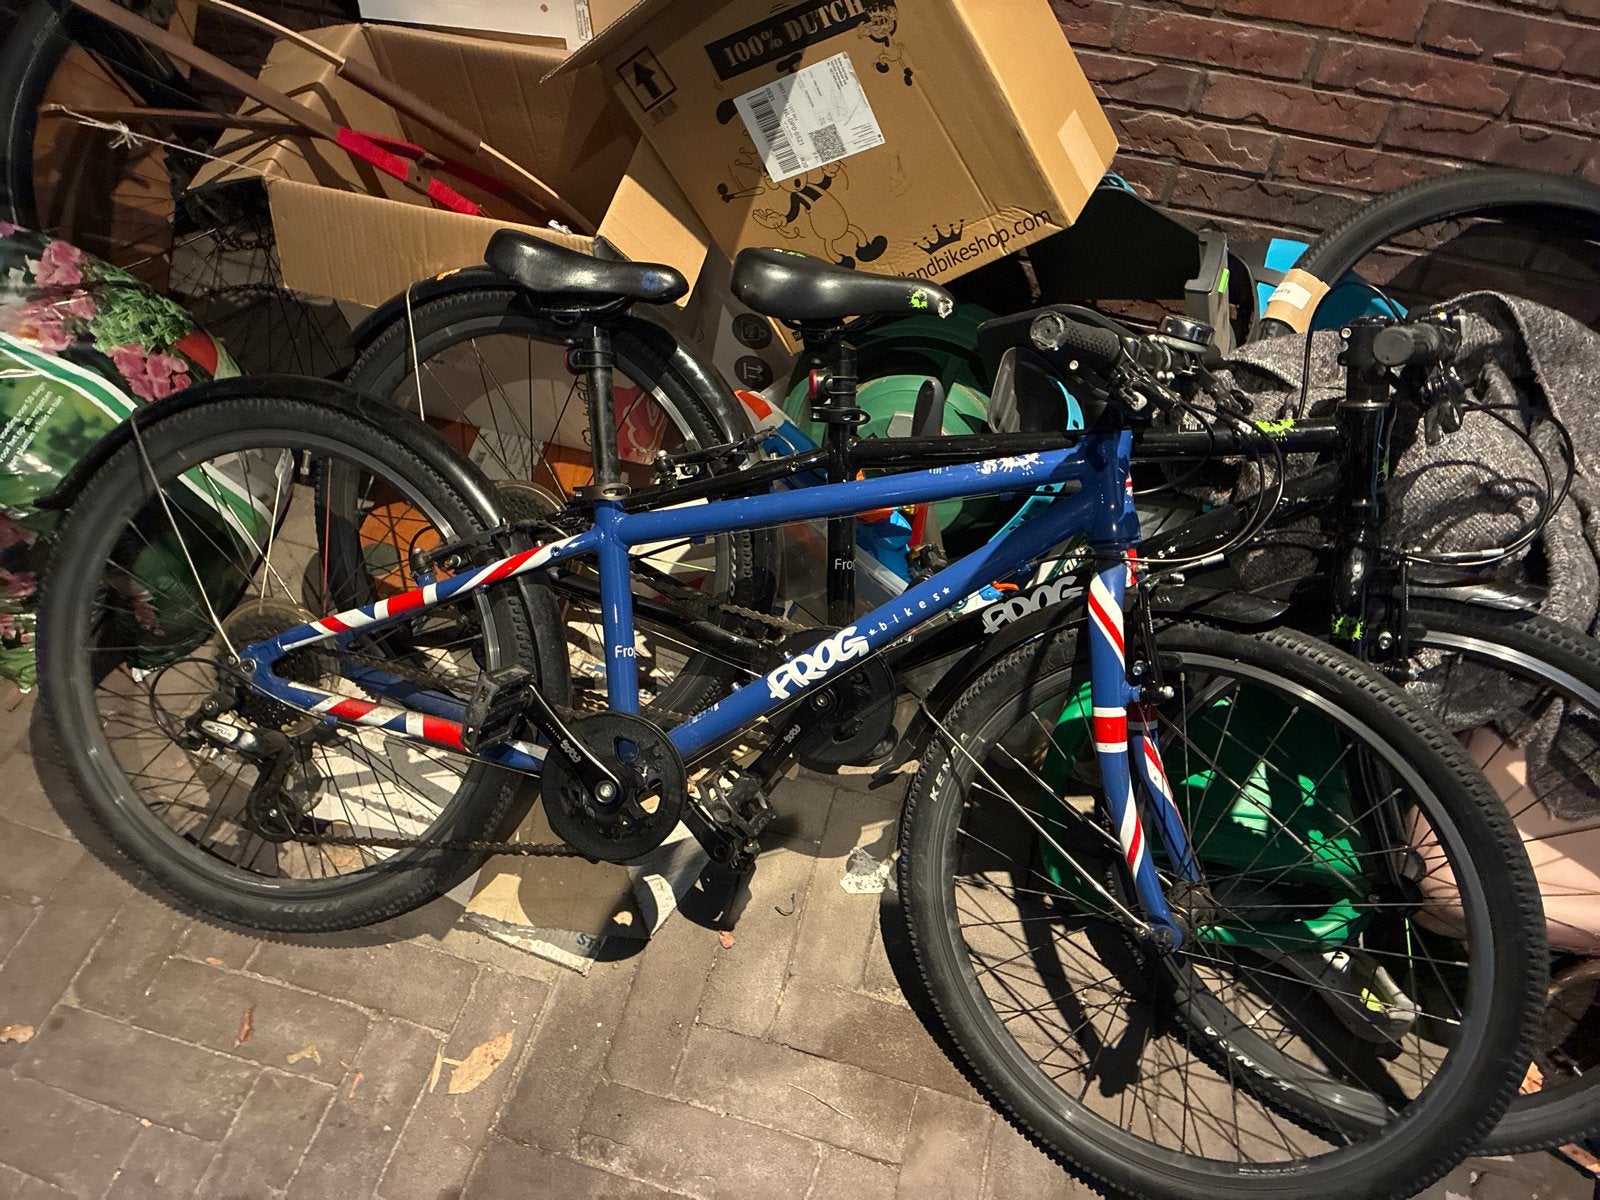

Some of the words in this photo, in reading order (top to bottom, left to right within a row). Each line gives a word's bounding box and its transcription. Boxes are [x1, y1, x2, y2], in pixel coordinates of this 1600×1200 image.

[723, 28, 783, 67] 100%
[783, 0, 866, 42] DUTCH
[897, 209, 1052, 279] ndbikeshop.com
[766, 625, 870, 700] FROG
[878, 592, 941, 632] bikes
[928, 732, 970, 802] KENDA
